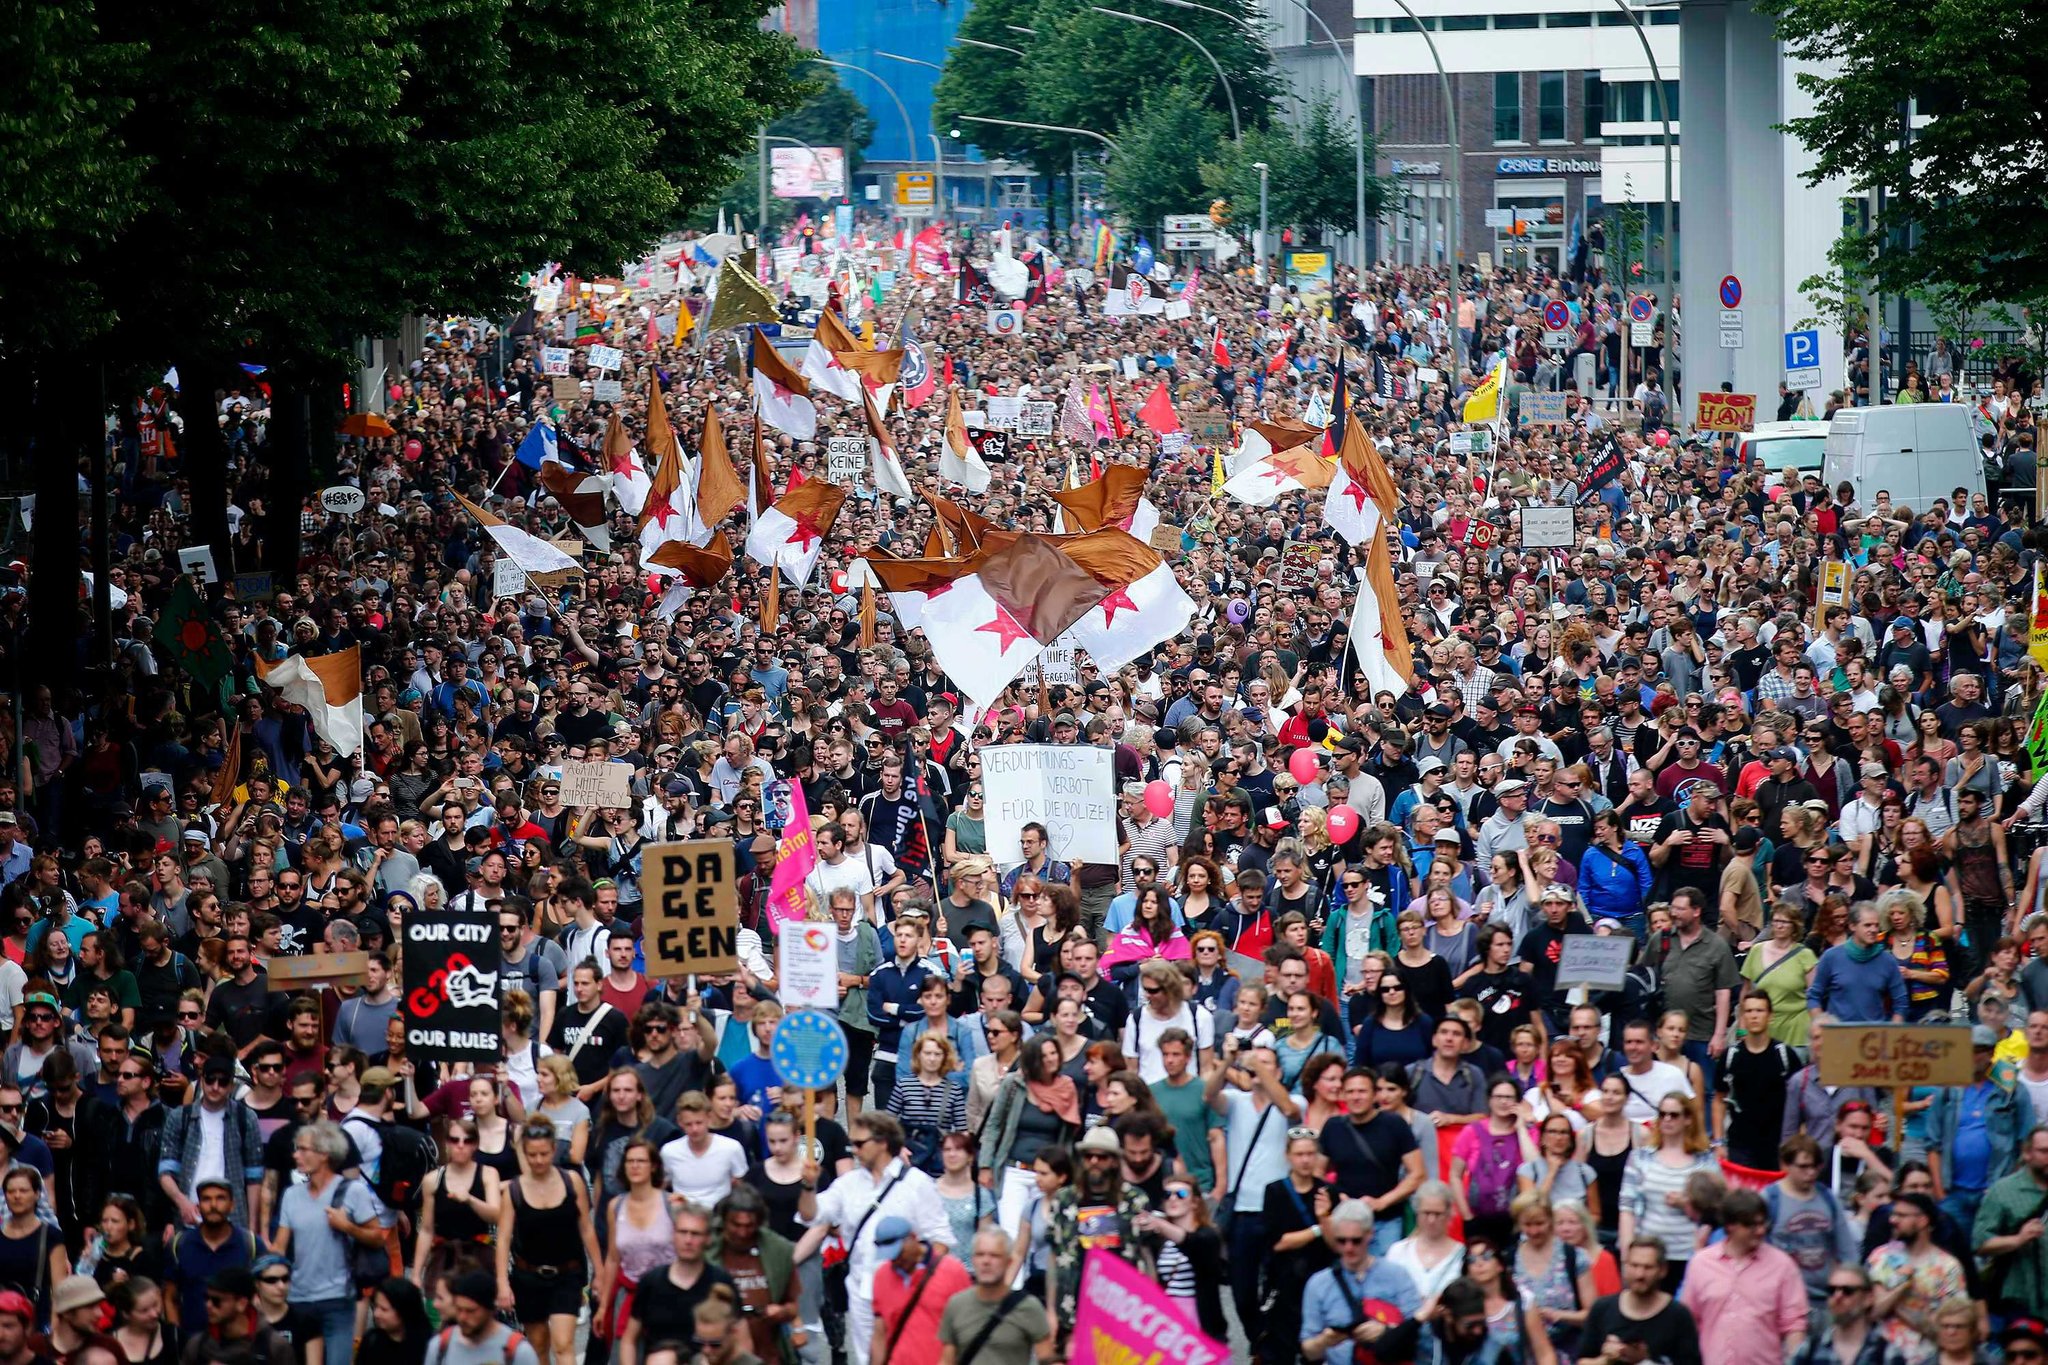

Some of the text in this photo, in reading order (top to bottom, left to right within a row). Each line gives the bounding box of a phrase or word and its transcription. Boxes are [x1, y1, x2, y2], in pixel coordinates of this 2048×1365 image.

[1792, 336, 1811, 364] P
[1701, 393, 1752, 407] NO
[830, 441, 847, 453] GIB
[830, 456, 862, 469] KEINE
[1047, 650, 1068, 663] HILFE
[1025, 665, 1045, 673] OHE
[567, 764, 616, 777] AGAINST
[983, 751, 1085, 773] VERDUMMUNGS-
[576, 777, 607, 792] WHITE
[1047, 776, 1093, 796] VERBOT
[562, 789, 624, 806] SUPREMACY
[1002, 798, 1038, 820] FÜR
[1045, 799, 1061, 817] DIE
[663, 852, 722, 885] DA
[662, 888, 715, 919] GE
[409, 924, 492, 943] OUR CITY
[658, 926, 737, 963] GEN
[409, 1030, 498, 1050] OUR RULES
[1895, 1062, 1931, 1081] G20
